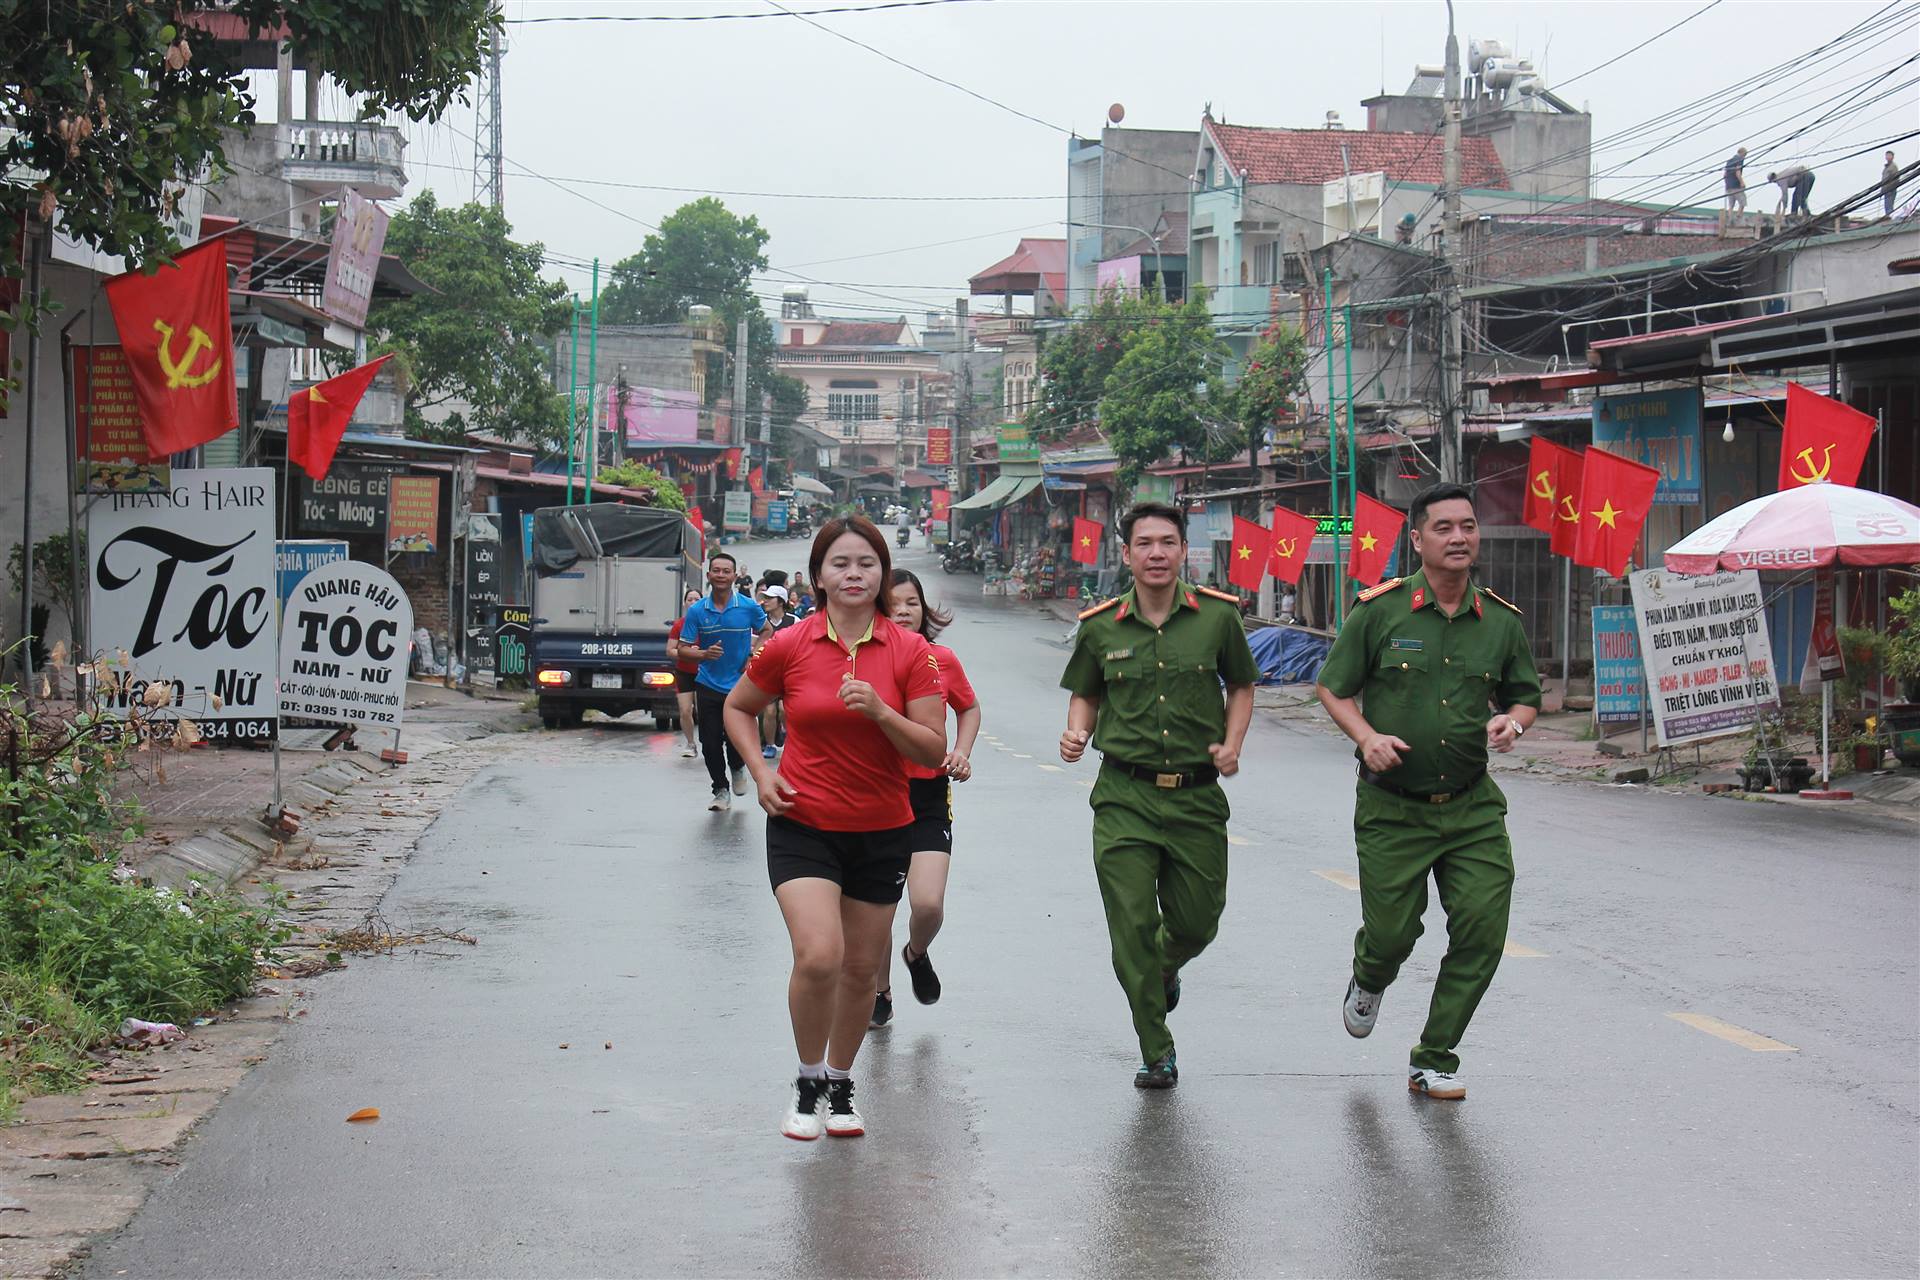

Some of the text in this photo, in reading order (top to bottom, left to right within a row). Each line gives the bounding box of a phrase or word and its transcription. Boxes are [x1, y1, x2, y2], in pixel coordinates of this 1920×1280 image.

[201, 481, 265, 511] HAIR
[304, 500, 325, 520] Tóc
[339, 501, 375, 527] Móng
[1737, 546, 1818, 566] viettel
[97, 526, 269, 658] Tóc
[304, 579, 400, 610] QUANG HẬU
[503, 610, 530, 623] Côn
[298, 606, 398, 661] TÓC
[581, 643, 633, 655] 20B-192.65
[1673, 648, 1705, 667] CHUẨN
[293, 660, 340, 678] NAM
[360, 666, 392, 683] NỮ
[214, 669, 262, 706] Nữ
[281, 701, 394, 723] ĐT: 0395 130 782
[1665, 692, 1691, 713] TRIỆT
[235, 721, 269, 738] 064
